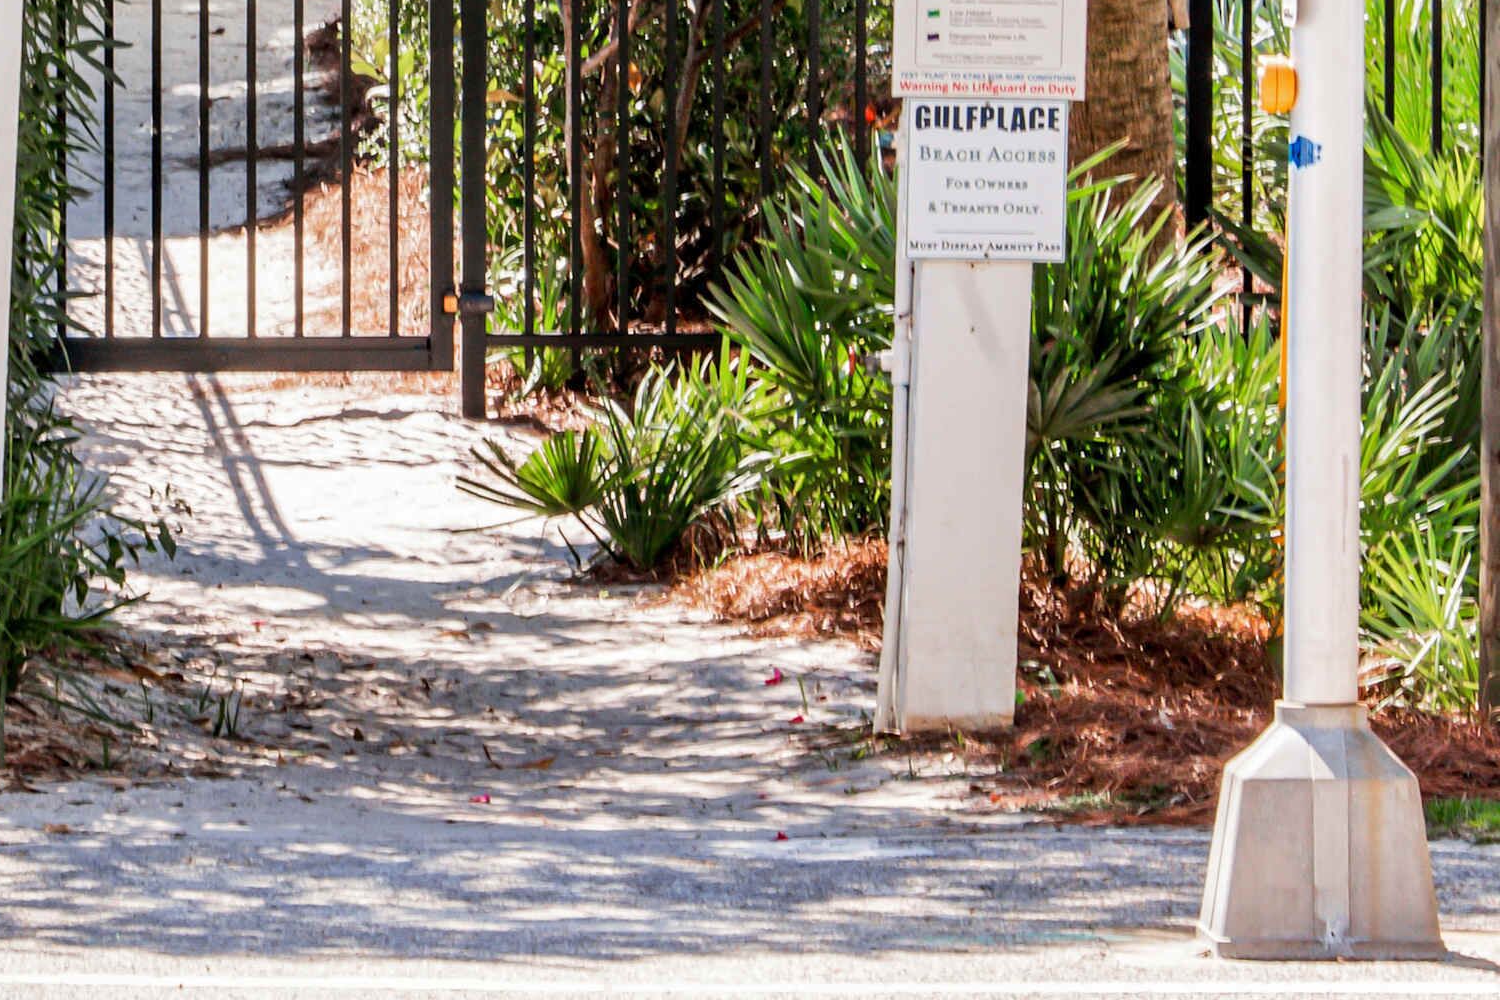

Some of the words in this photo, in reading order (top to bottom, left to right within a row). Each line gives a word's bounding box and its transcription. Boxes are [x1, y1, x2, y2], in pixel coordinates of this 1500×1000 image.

[900, 80, 948, 94] Warning
[952, 81, 969, 92] No
[1030, 85, 1045, 94] on
[1048, 83, 1077, 97] Duty
[915, 104, 1060, 133] GULFPLACE
[920, 145, 981, 163] BEACH
[987, 146, 1057, 164] ACCESS
[928, 202, 937, 213] &
